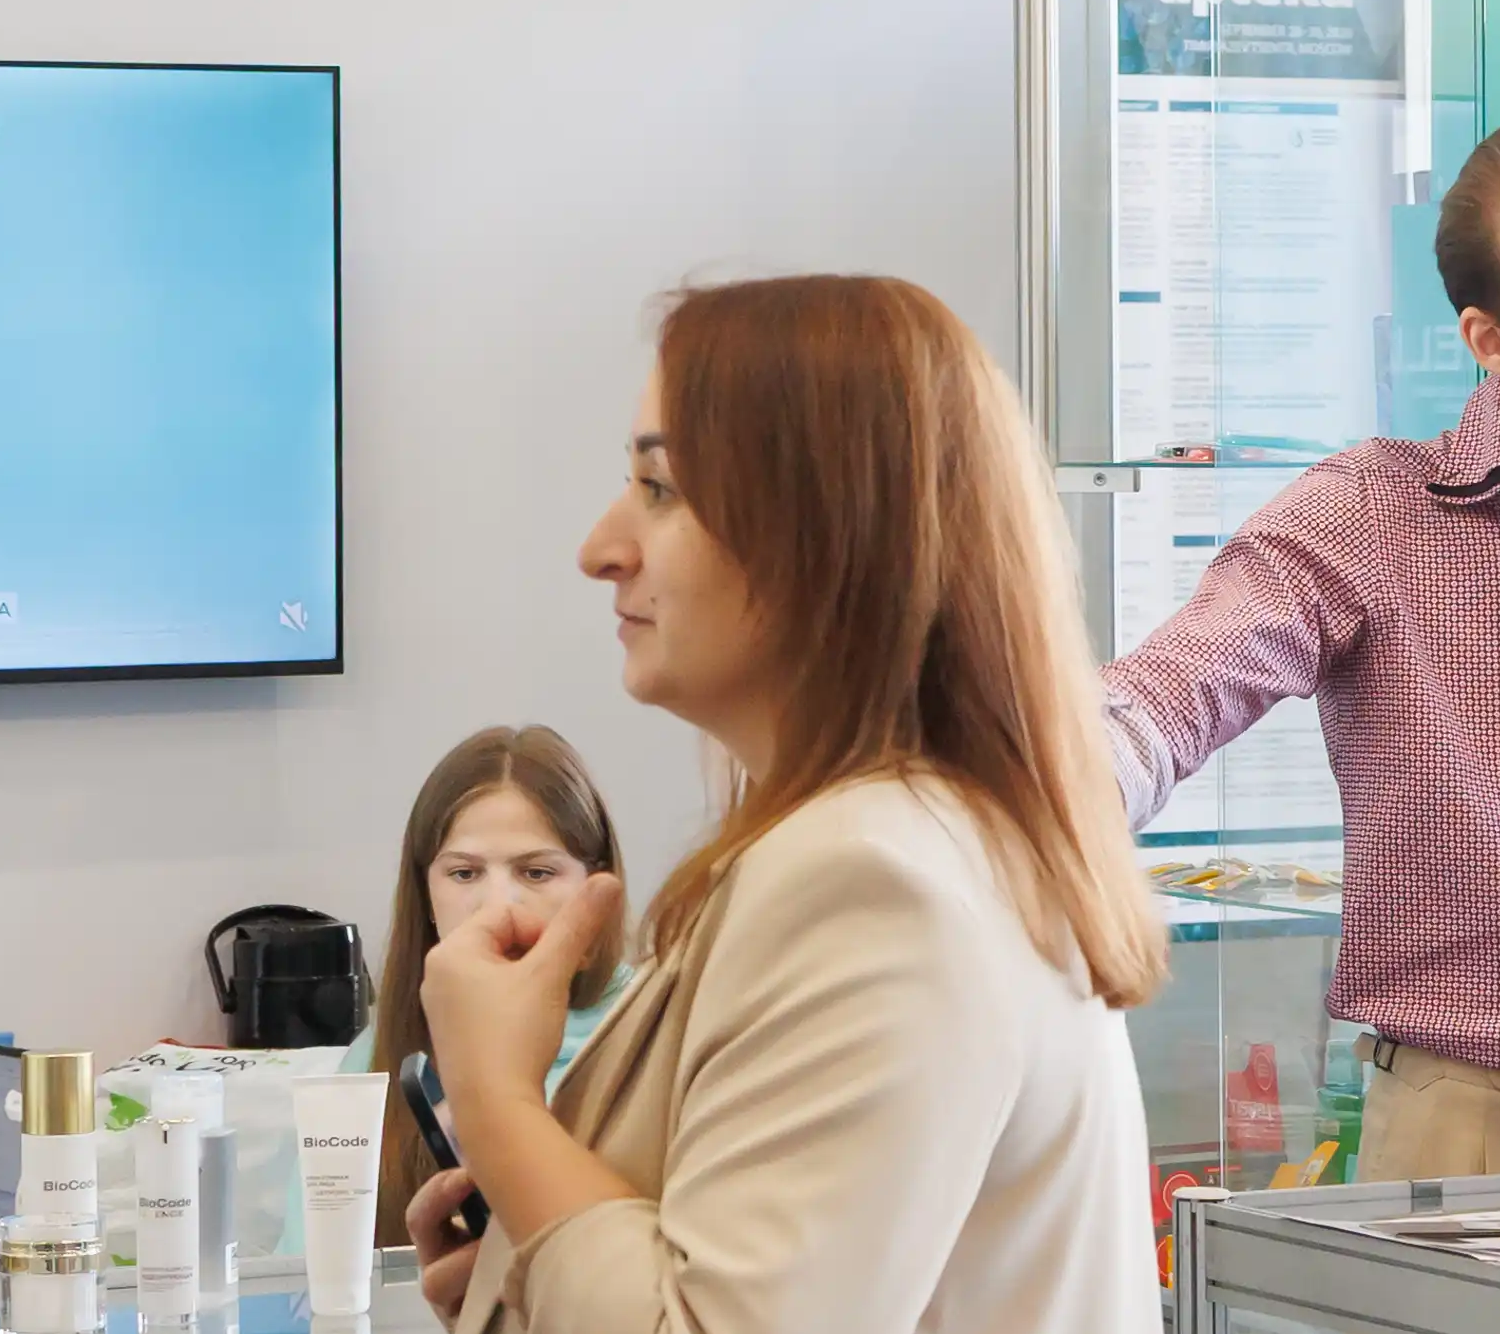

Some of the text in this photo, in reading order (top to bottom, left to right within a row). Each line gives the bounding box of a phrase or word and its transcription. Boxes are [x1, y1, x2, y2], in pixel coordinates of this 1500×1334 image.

[303, 1136, 369, 1148] BioCode
[43, 1179, 96, 1192] BioCod
[138, 1197, 192, 1209] BioCode
